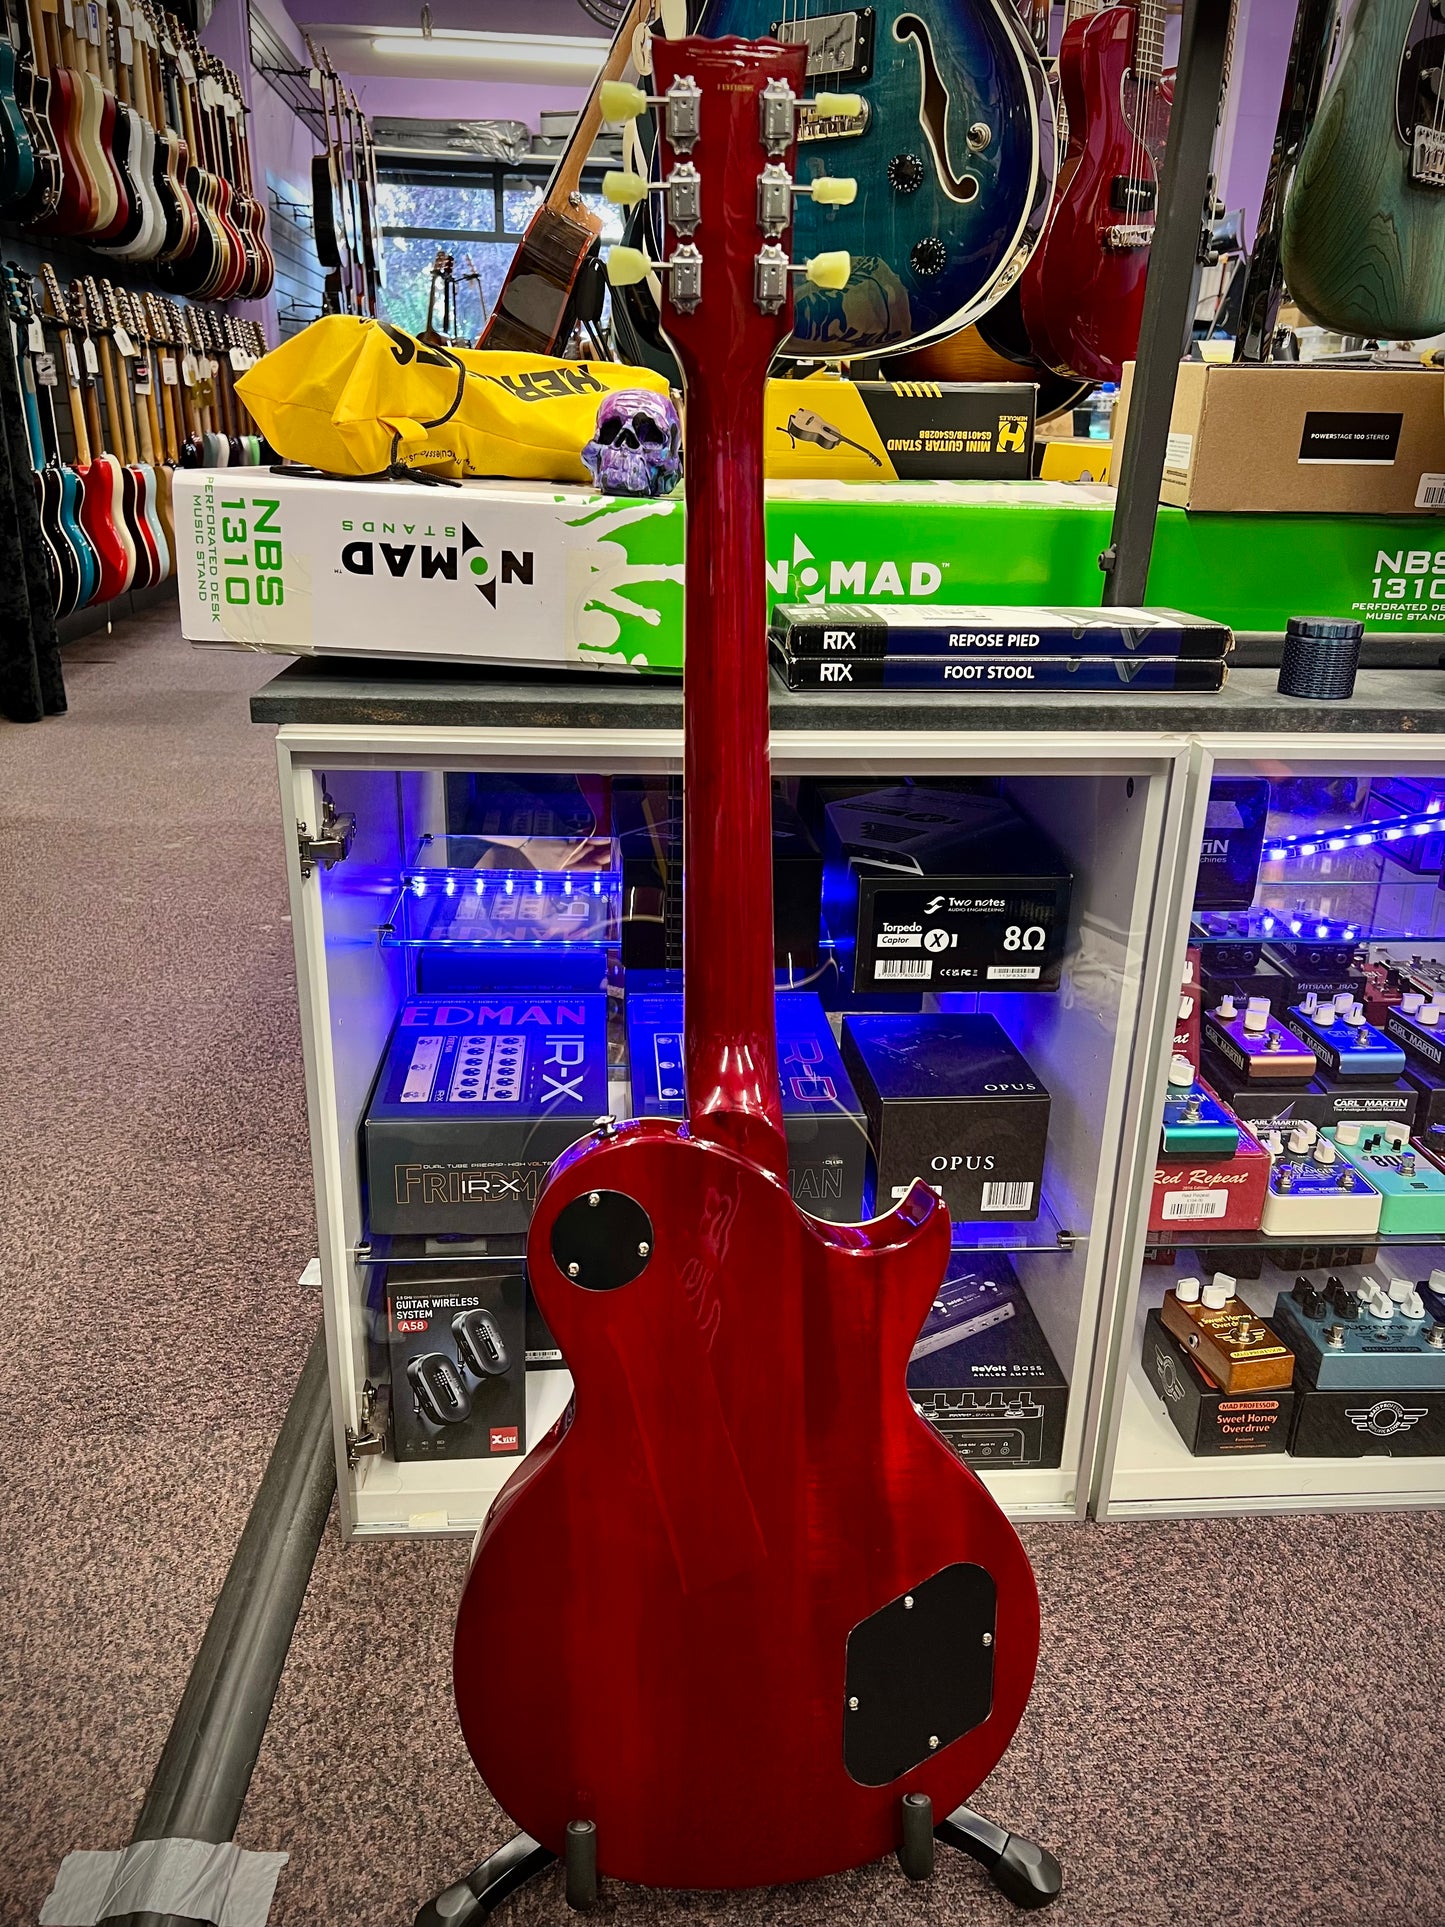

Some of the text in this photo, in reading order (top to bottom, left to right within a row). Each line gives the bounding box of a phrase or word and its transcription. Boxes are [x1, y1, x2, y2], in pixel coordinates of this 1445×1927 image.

[887, 439, 991, 452] MINI GUITAR STAND
[342, 520, 456, 537] STANDS
[193, 495, 207, 602] MUSIC STAND
[204, 476, 221, 623] PERFORATED DESK
[221, 497, 250, 605] 1310
[252, 499, 284, 606] NBS
[1352, 603, 1428, 611] PERFORATED
[823, 631, 857, 650] RTX
[949, 634, 1040, 648] REPOSE PIED
[820, 664, 853, 682] RTX
[944, 665, 1035, 680] FOOT STOOL
[949, 897, 1005, 907] Two notes
[883, 922, 922, 934] Torpedo
[882, 936, 909, 944] Captor
[984, 1083, 1036, 1091] OPUS
[1334, 1098, 1408, 1107] CARL MARTIN
[931, 1156, 995, 1171] OPUS
[395, 1164, 539, 1204] FRIEDM
[1188, 1169, 1249, 1187] Repeat
[461, 1178, 521, 1194] IR-X
[396, 1297, 479, 1310] GUITAR WIRELESS
[396, 1309, 433, 1320] SYSTEM
[401, 1321, 424, 1331] A58
[971, 1364, 1042, 1372] ReVolt Bass
[1222, 1401, 1276, 1410] MAD PROFESSOR
[1217, 1413, 1278, 1424] Sweet Honey
[1222, 1423, 1270, 1434] Overdrive
